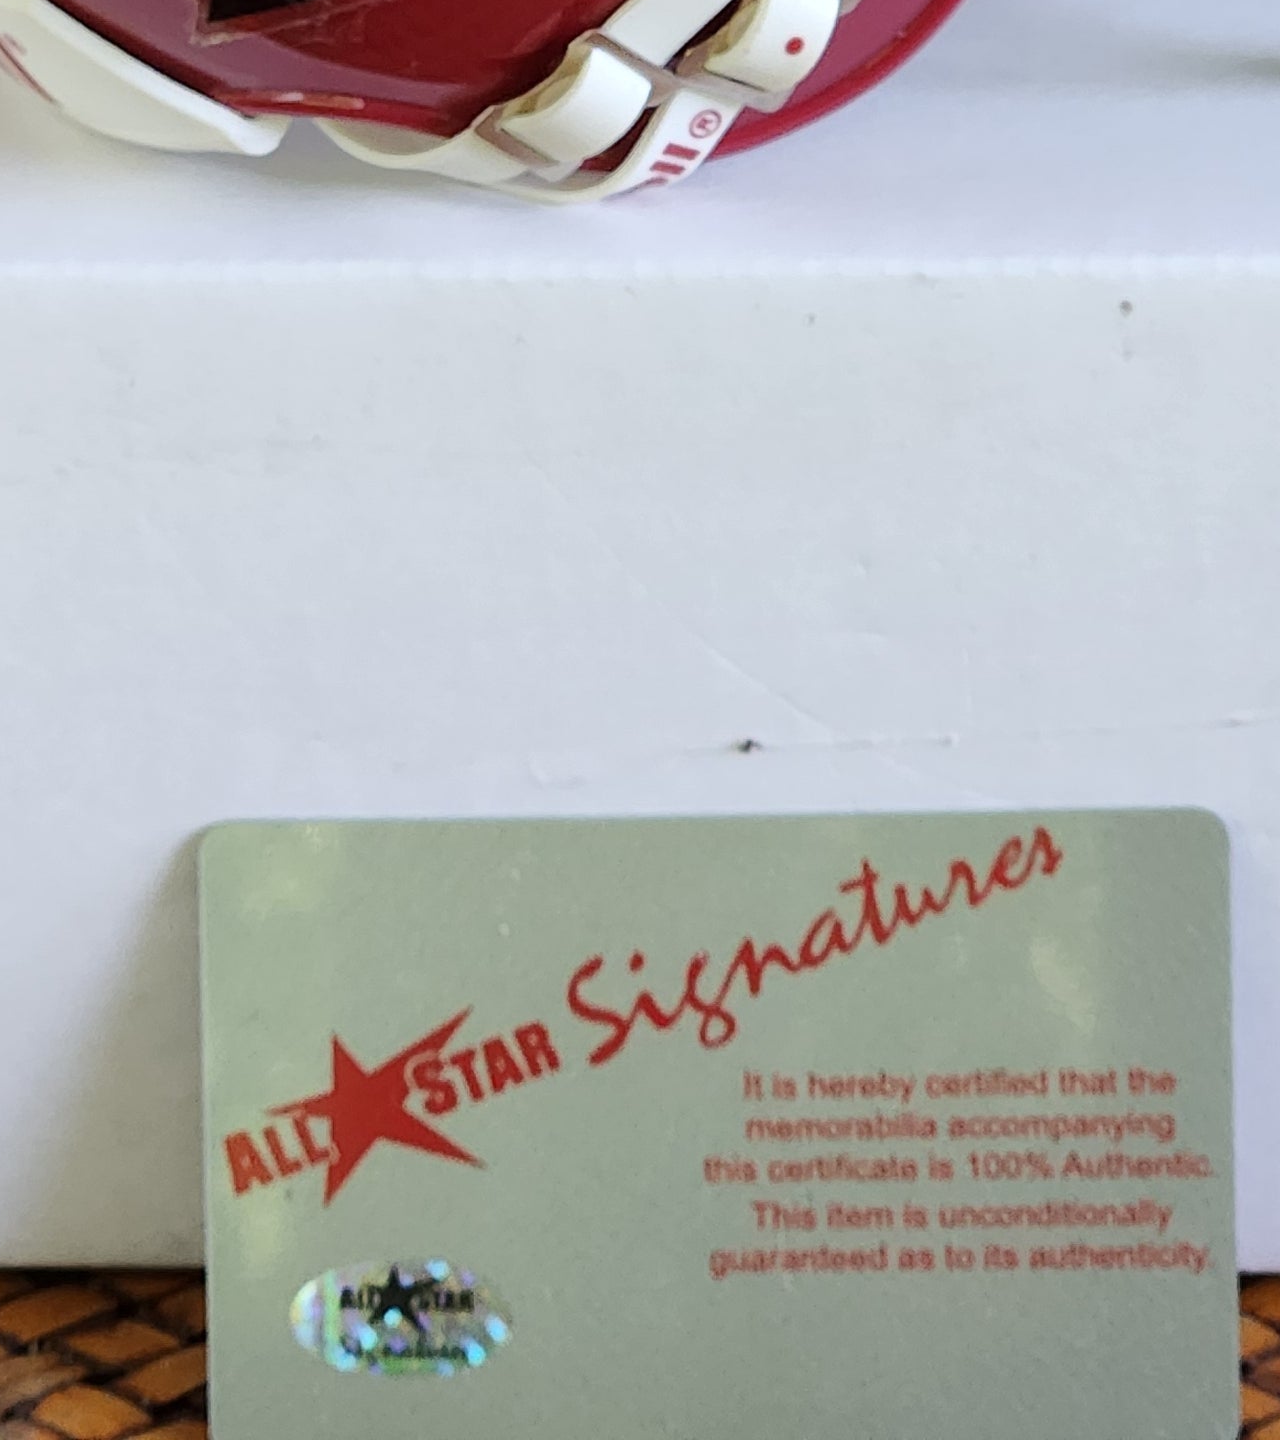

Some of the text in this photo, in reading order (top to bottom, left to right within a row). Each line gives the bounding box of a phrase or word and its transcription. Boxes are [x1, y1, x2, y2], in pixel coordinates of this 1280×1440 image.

[224, 825, 1063, 1197] ALL STAR Signatures
[742, 1066, 1177, 1104] It is hereby certified that the
[744, 1112, 1176, 1145] memorabilia accompanying
[703, 1154, 757, 1184] this
[766, 1153, 919, 1184] certificate
[928, 1152, 954, 1182] is
[969, 1151, 1055, 1180] 100%
[752, 1198, 1174, 1235] This item is unconditionally
[709, 1242, 889, 1281] guaranteed
[898, 1247, 935, 1272] as
[945, 1242, 975, 1272] to
[983, 1243, 1018, 1271] its
